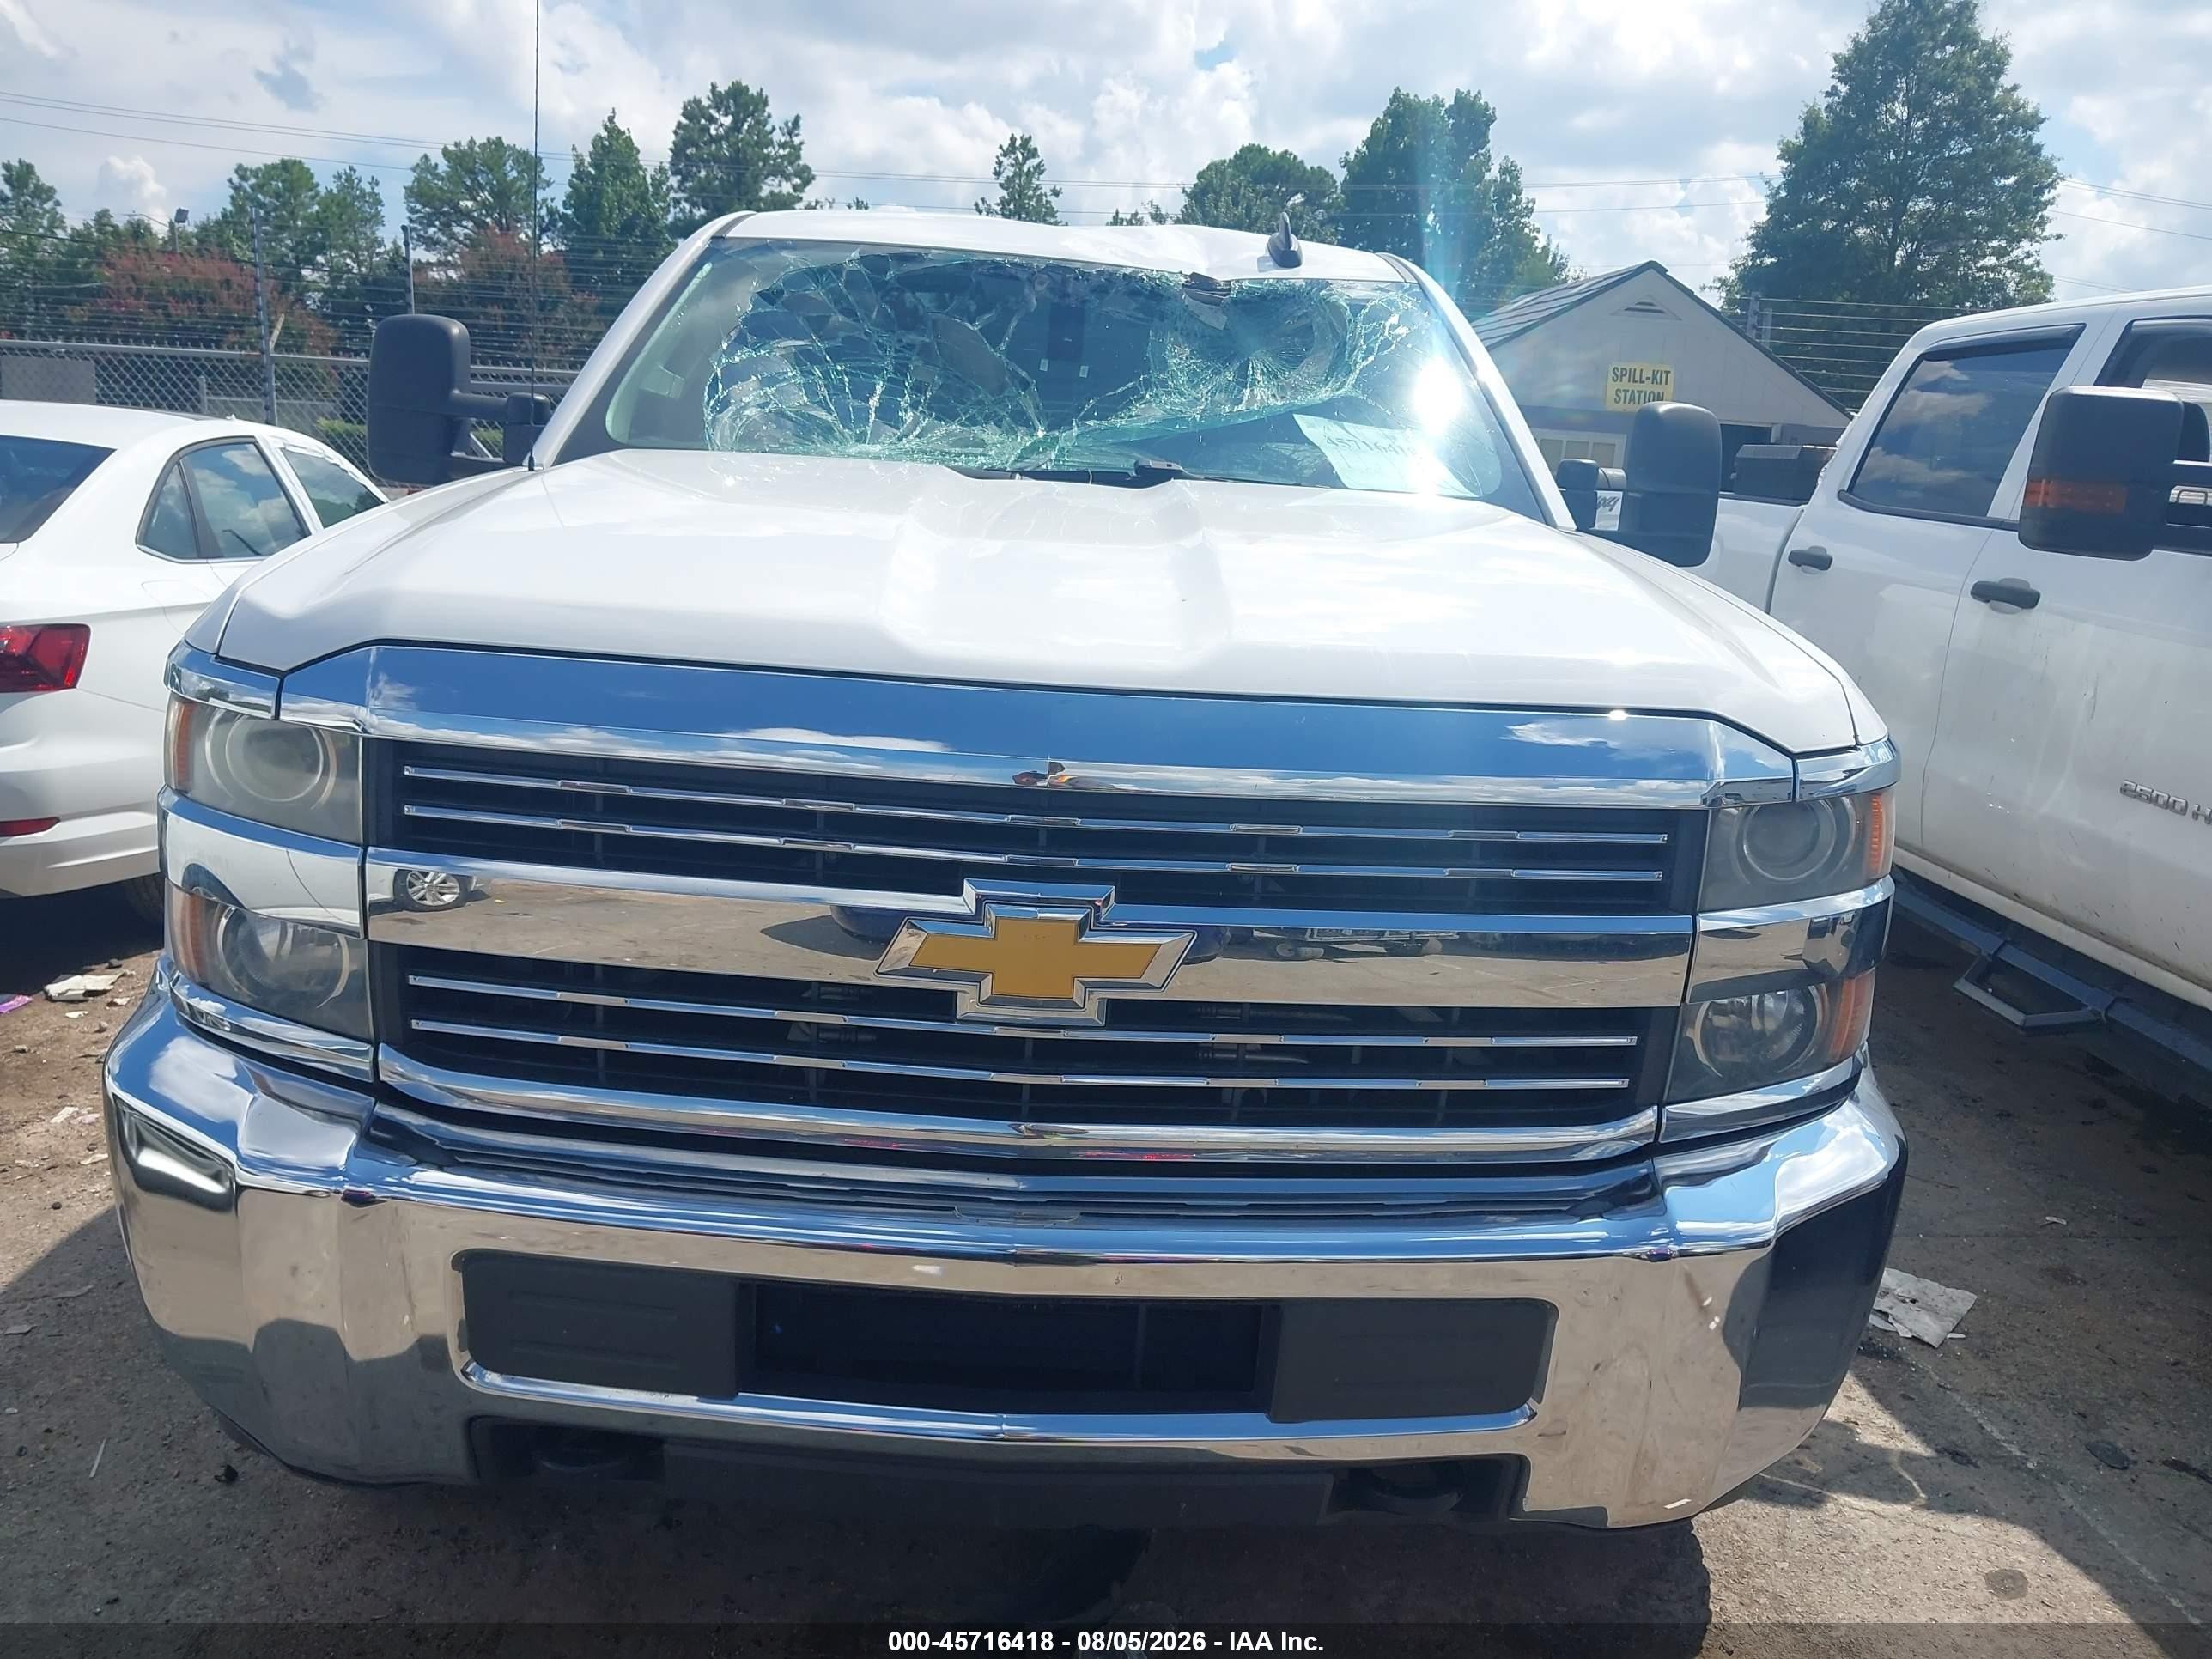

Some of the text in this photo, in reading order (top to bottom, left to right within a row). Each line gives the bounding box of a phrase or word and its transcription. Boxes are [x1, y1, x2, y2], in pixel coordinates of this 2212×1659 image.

[1612, 367, 1671, 385] SPILL-KIT
[1614, 388, 1664, 404] STATION
[2119, 779, 2188, 816] 2500
